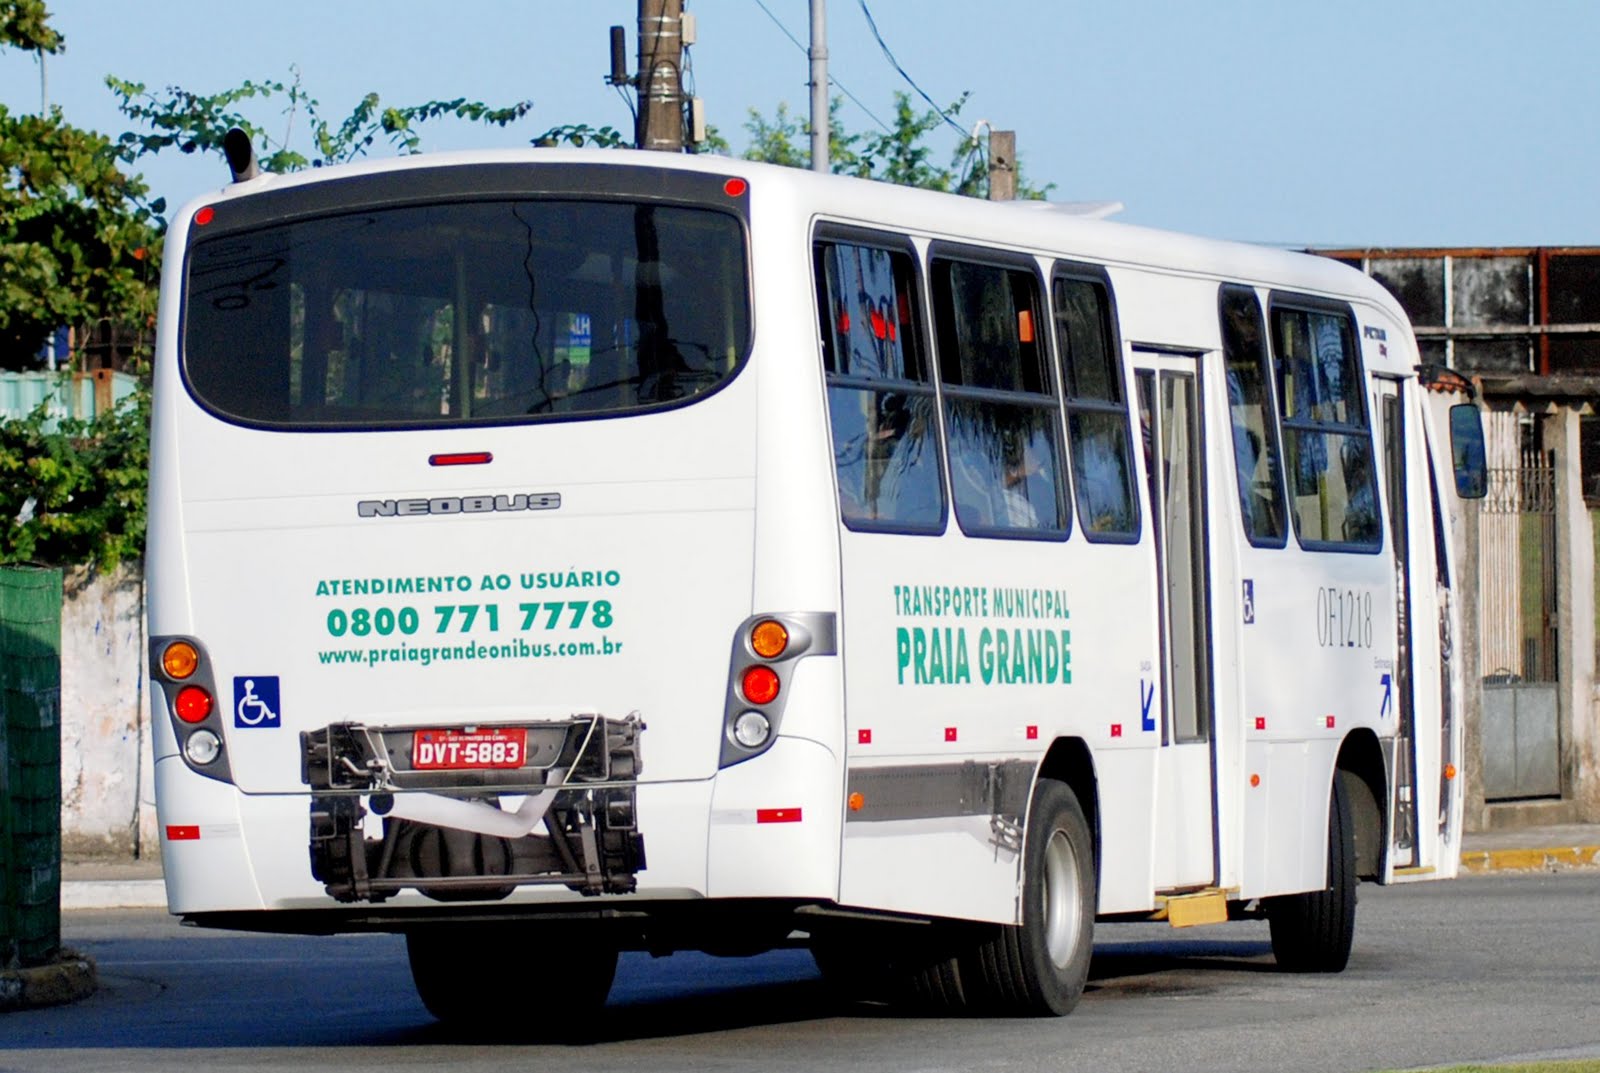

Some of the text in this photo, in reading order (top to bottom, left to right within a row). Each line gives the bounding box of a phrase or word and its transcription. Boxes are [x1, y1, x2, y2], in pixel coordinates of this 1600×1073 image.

[357, 493, 561, 518] NEOBUS
[315, 566, 621, 597] ATENDIMENTO AO USUÁRIO
[326, 600, 614, 638] 0800 771 7778
[894, 585, 1070, 619] TRANSPORTE MUNICIPAL
[1317, 586, 1373, 649] OF1218
[318, 635, 623, 668] www.praiagrandeonibus.com.br
[896, 627, 1073, 686] PRAIA GRANDE
